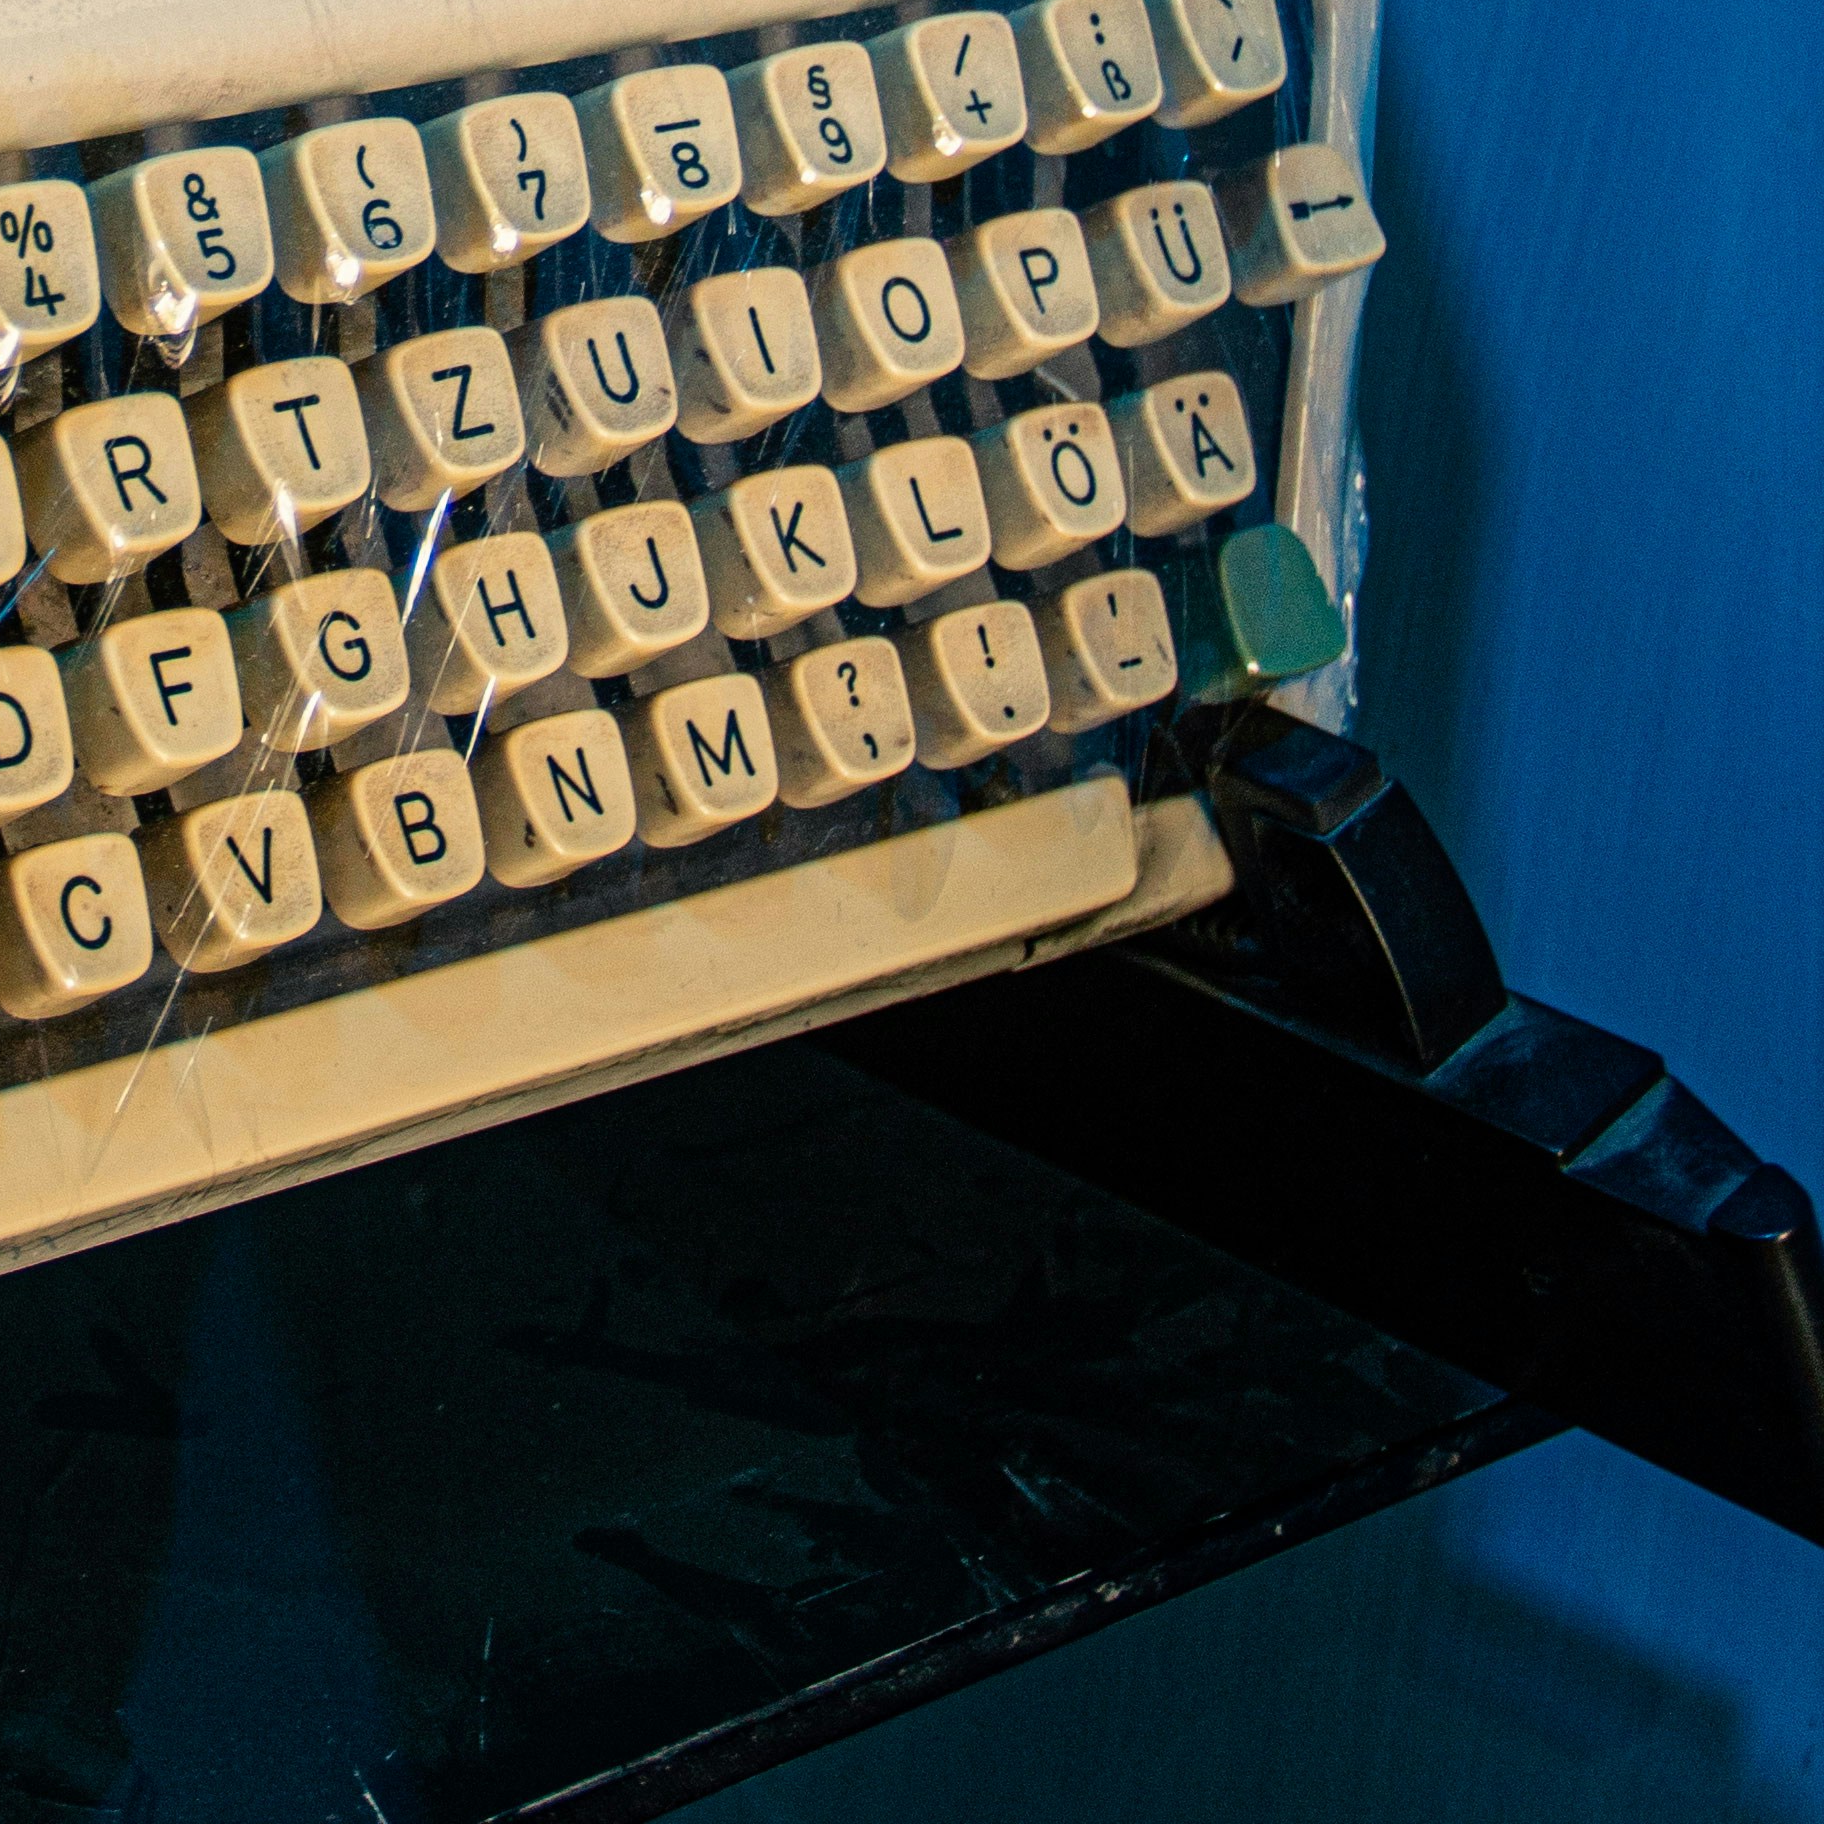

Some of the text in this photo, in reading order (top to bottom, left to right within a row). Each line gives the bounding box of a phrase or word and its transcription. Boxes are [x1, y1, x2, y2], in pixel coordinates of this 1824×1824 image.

[671, 141, 710, 190] 8
[819, 117, 854, 165] 9
[0, 203, 54, 259] %
[182, 172, 220, 223] &
[361, 198, 404, 251] 6
[517, 169, 547, 221] 7
[196, 227, 237, 281] 5
[1150, 202, 1203, 286] Ü
[24, 266, 66, 317] 4
[881, 276, 932, 344] O
[1018, 247, 1060, 315] P
[431, 364, 495, 441] Z
[587, 331, 640, 405] U
[272, 394, 321, 471] T
[1042, 422, 1097, 508] Ö
[1174, 393, 1235, 479] Ä
[103, 435, 168, 512] R
[770, 501, 827, 574] K
[909, 477, 964, 544] L
[477, 569, 537, 648] H
[629, 537, 670, 610] J
[318, 610, 372, 683] G
[149, 646, 193, 726] F
[837, 661, 860, 708] ?
[546, 747, 605, 823] N
[686, 709, 756, 788] M
[393, 791, 447, 866] B
[225, 827, 273, 905] V
[59, 875, 113, 951] C
